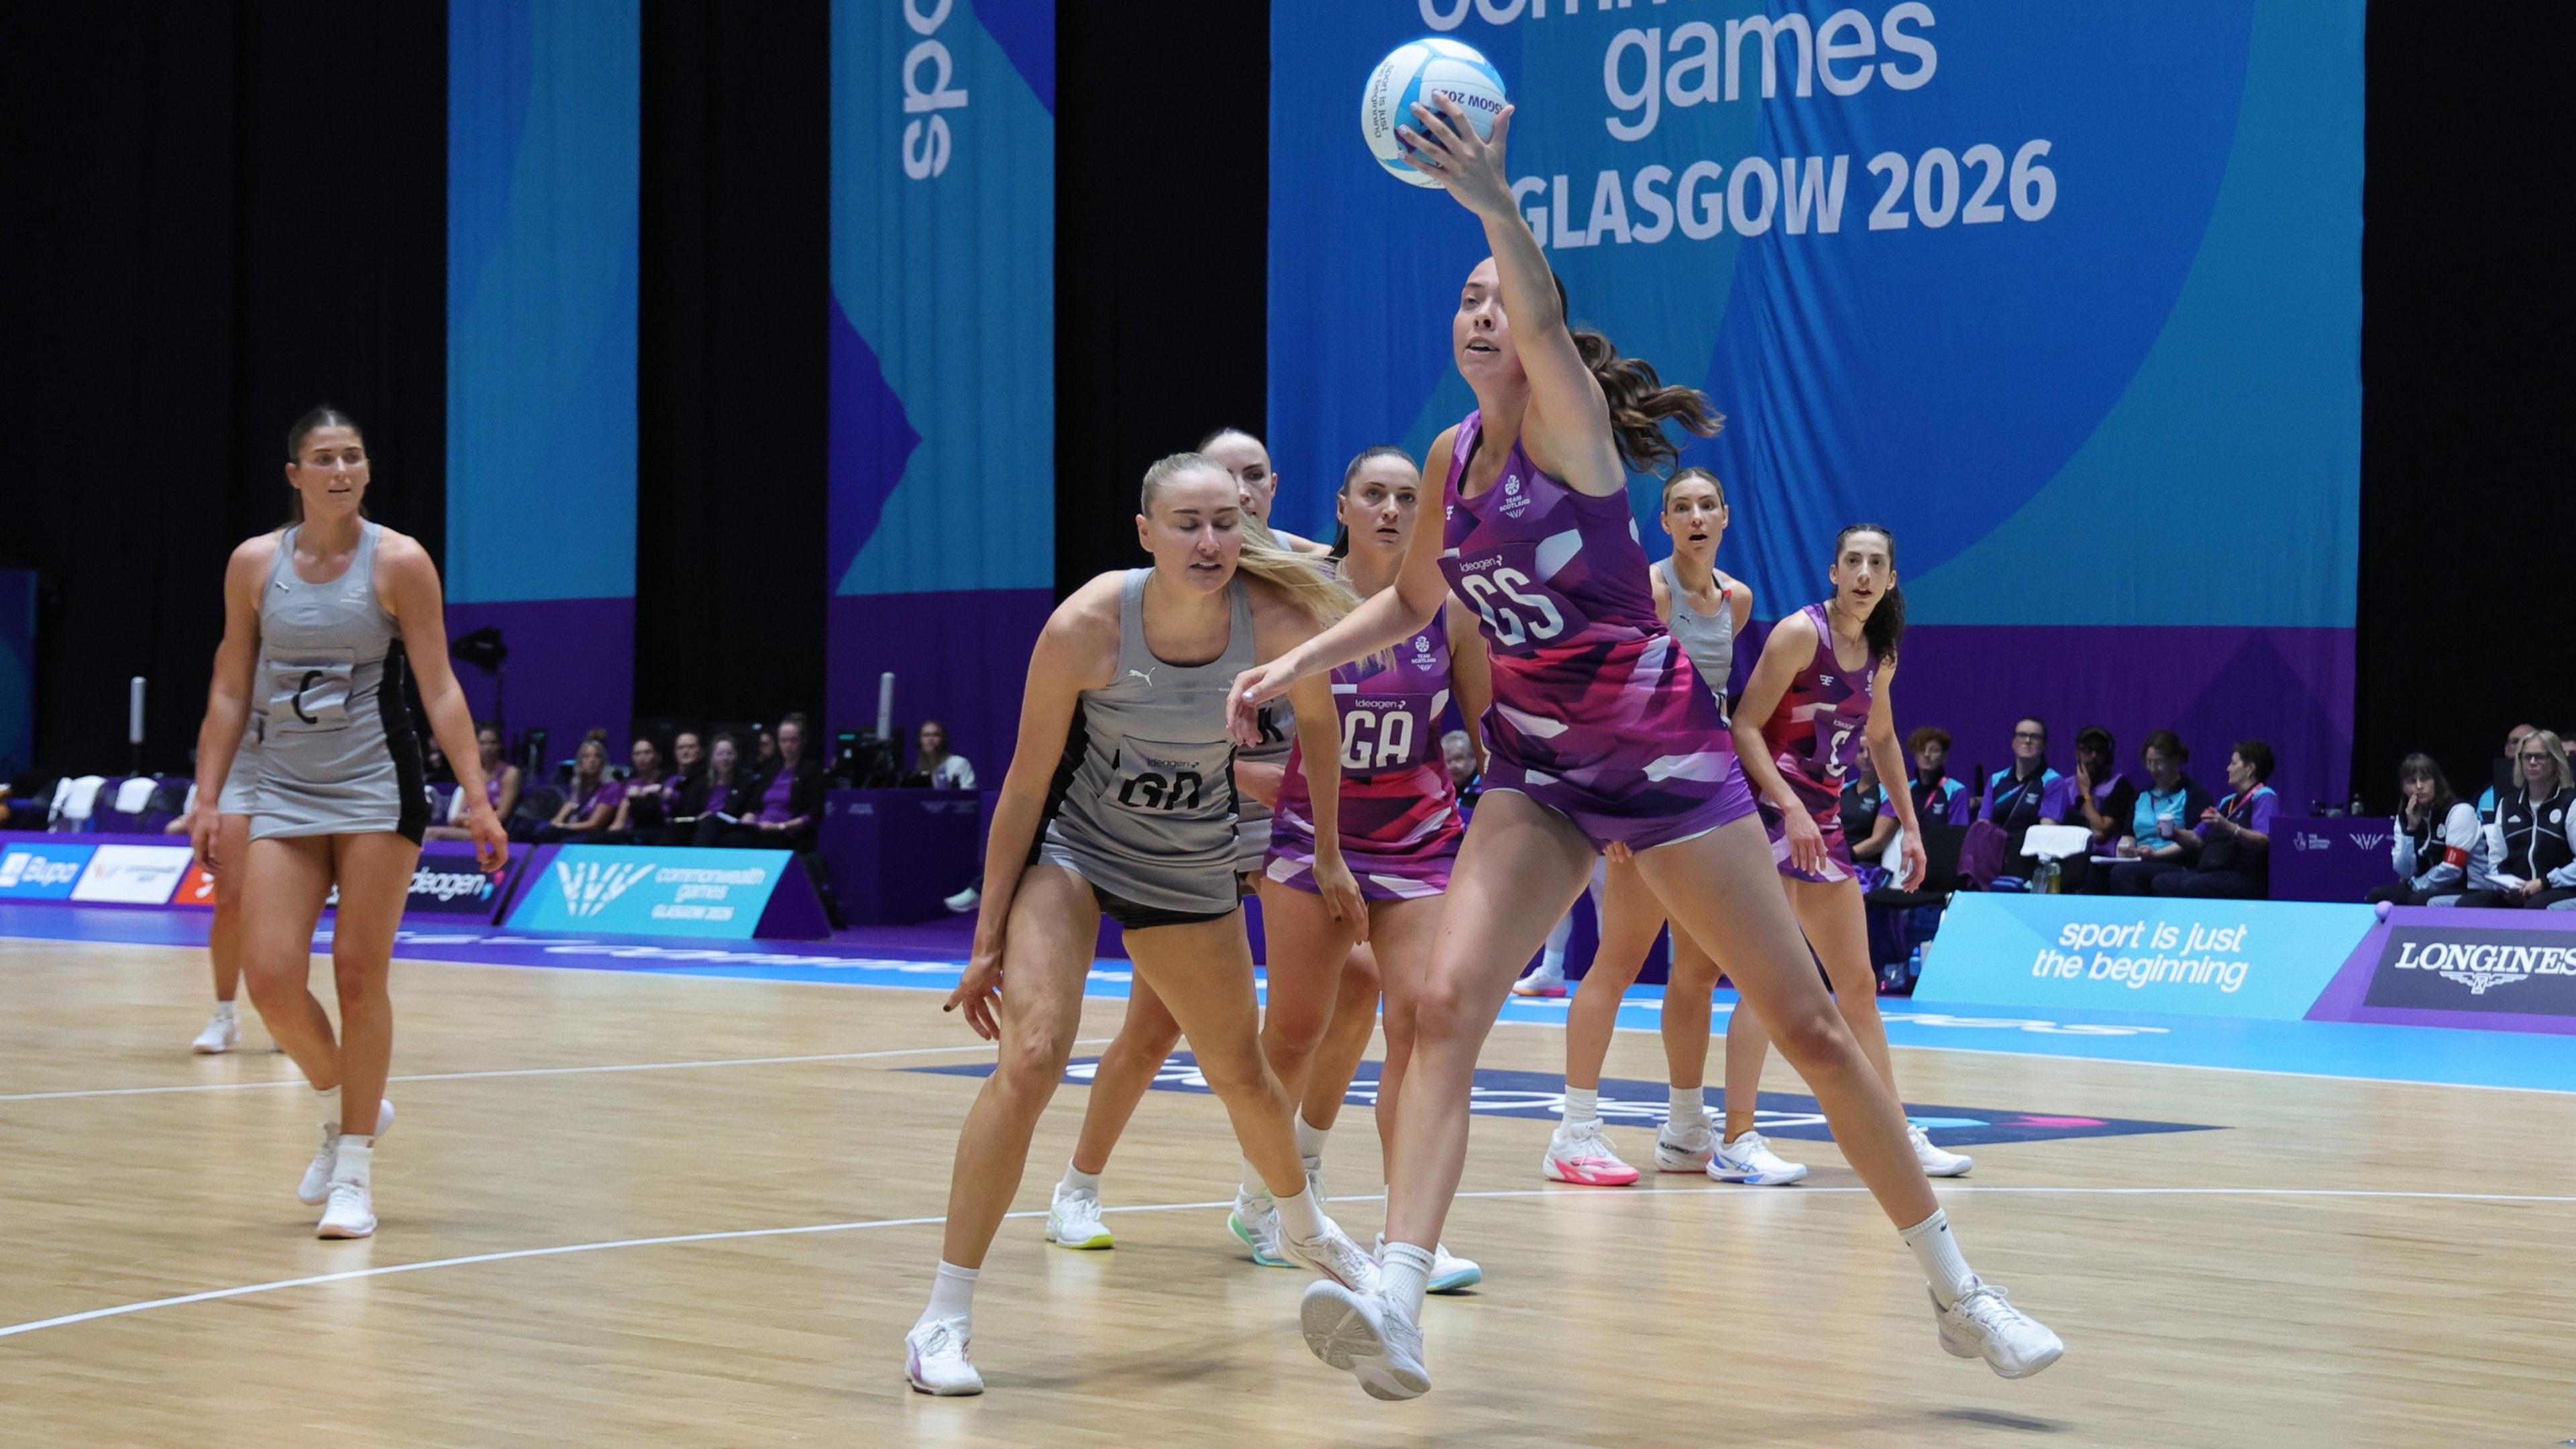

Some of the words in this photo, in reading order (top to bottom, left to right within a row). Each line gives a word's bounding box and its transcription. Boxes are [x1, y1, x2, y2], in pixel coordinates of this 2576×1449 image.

[1380, 64, 1394, 93] sport
[1604, 1, 1937, 141] games
[1379, 96, 1386, 107] is
[1468, 95, 1503, 115] SGOW
[1377, 109, 1389, 131] just
[1511, 154, 1849, 249] GLASGOW
[1866, 139, 2057, 231] 2026
[1499, 498, 1531, 512] SCOTLAND
[1506, 495, 1522, 504] TEAM
[1460, 557, 1495, 572] Ideagen
[1462, 568, 1564, 646] GS
[292, 669, 323, 724] C
[1355, 699, 1397, 710] Ideagen
[1340, 710, 1413, 769] GA
[1825, 730, 1851, 777] C
[1147, 757, 1190, 769] Ideagen
[408, 865, 486, 902] deagen
[2058, 920, 2146, 951] sport
[2150, 921, 2180, 950] is
[2179, 922, 2247, 957] just
[2032, 949, 2084, 979] the
[2088, 951, 2249, 994] beginning
[2394, 942, 2576, 976] LONGINES
